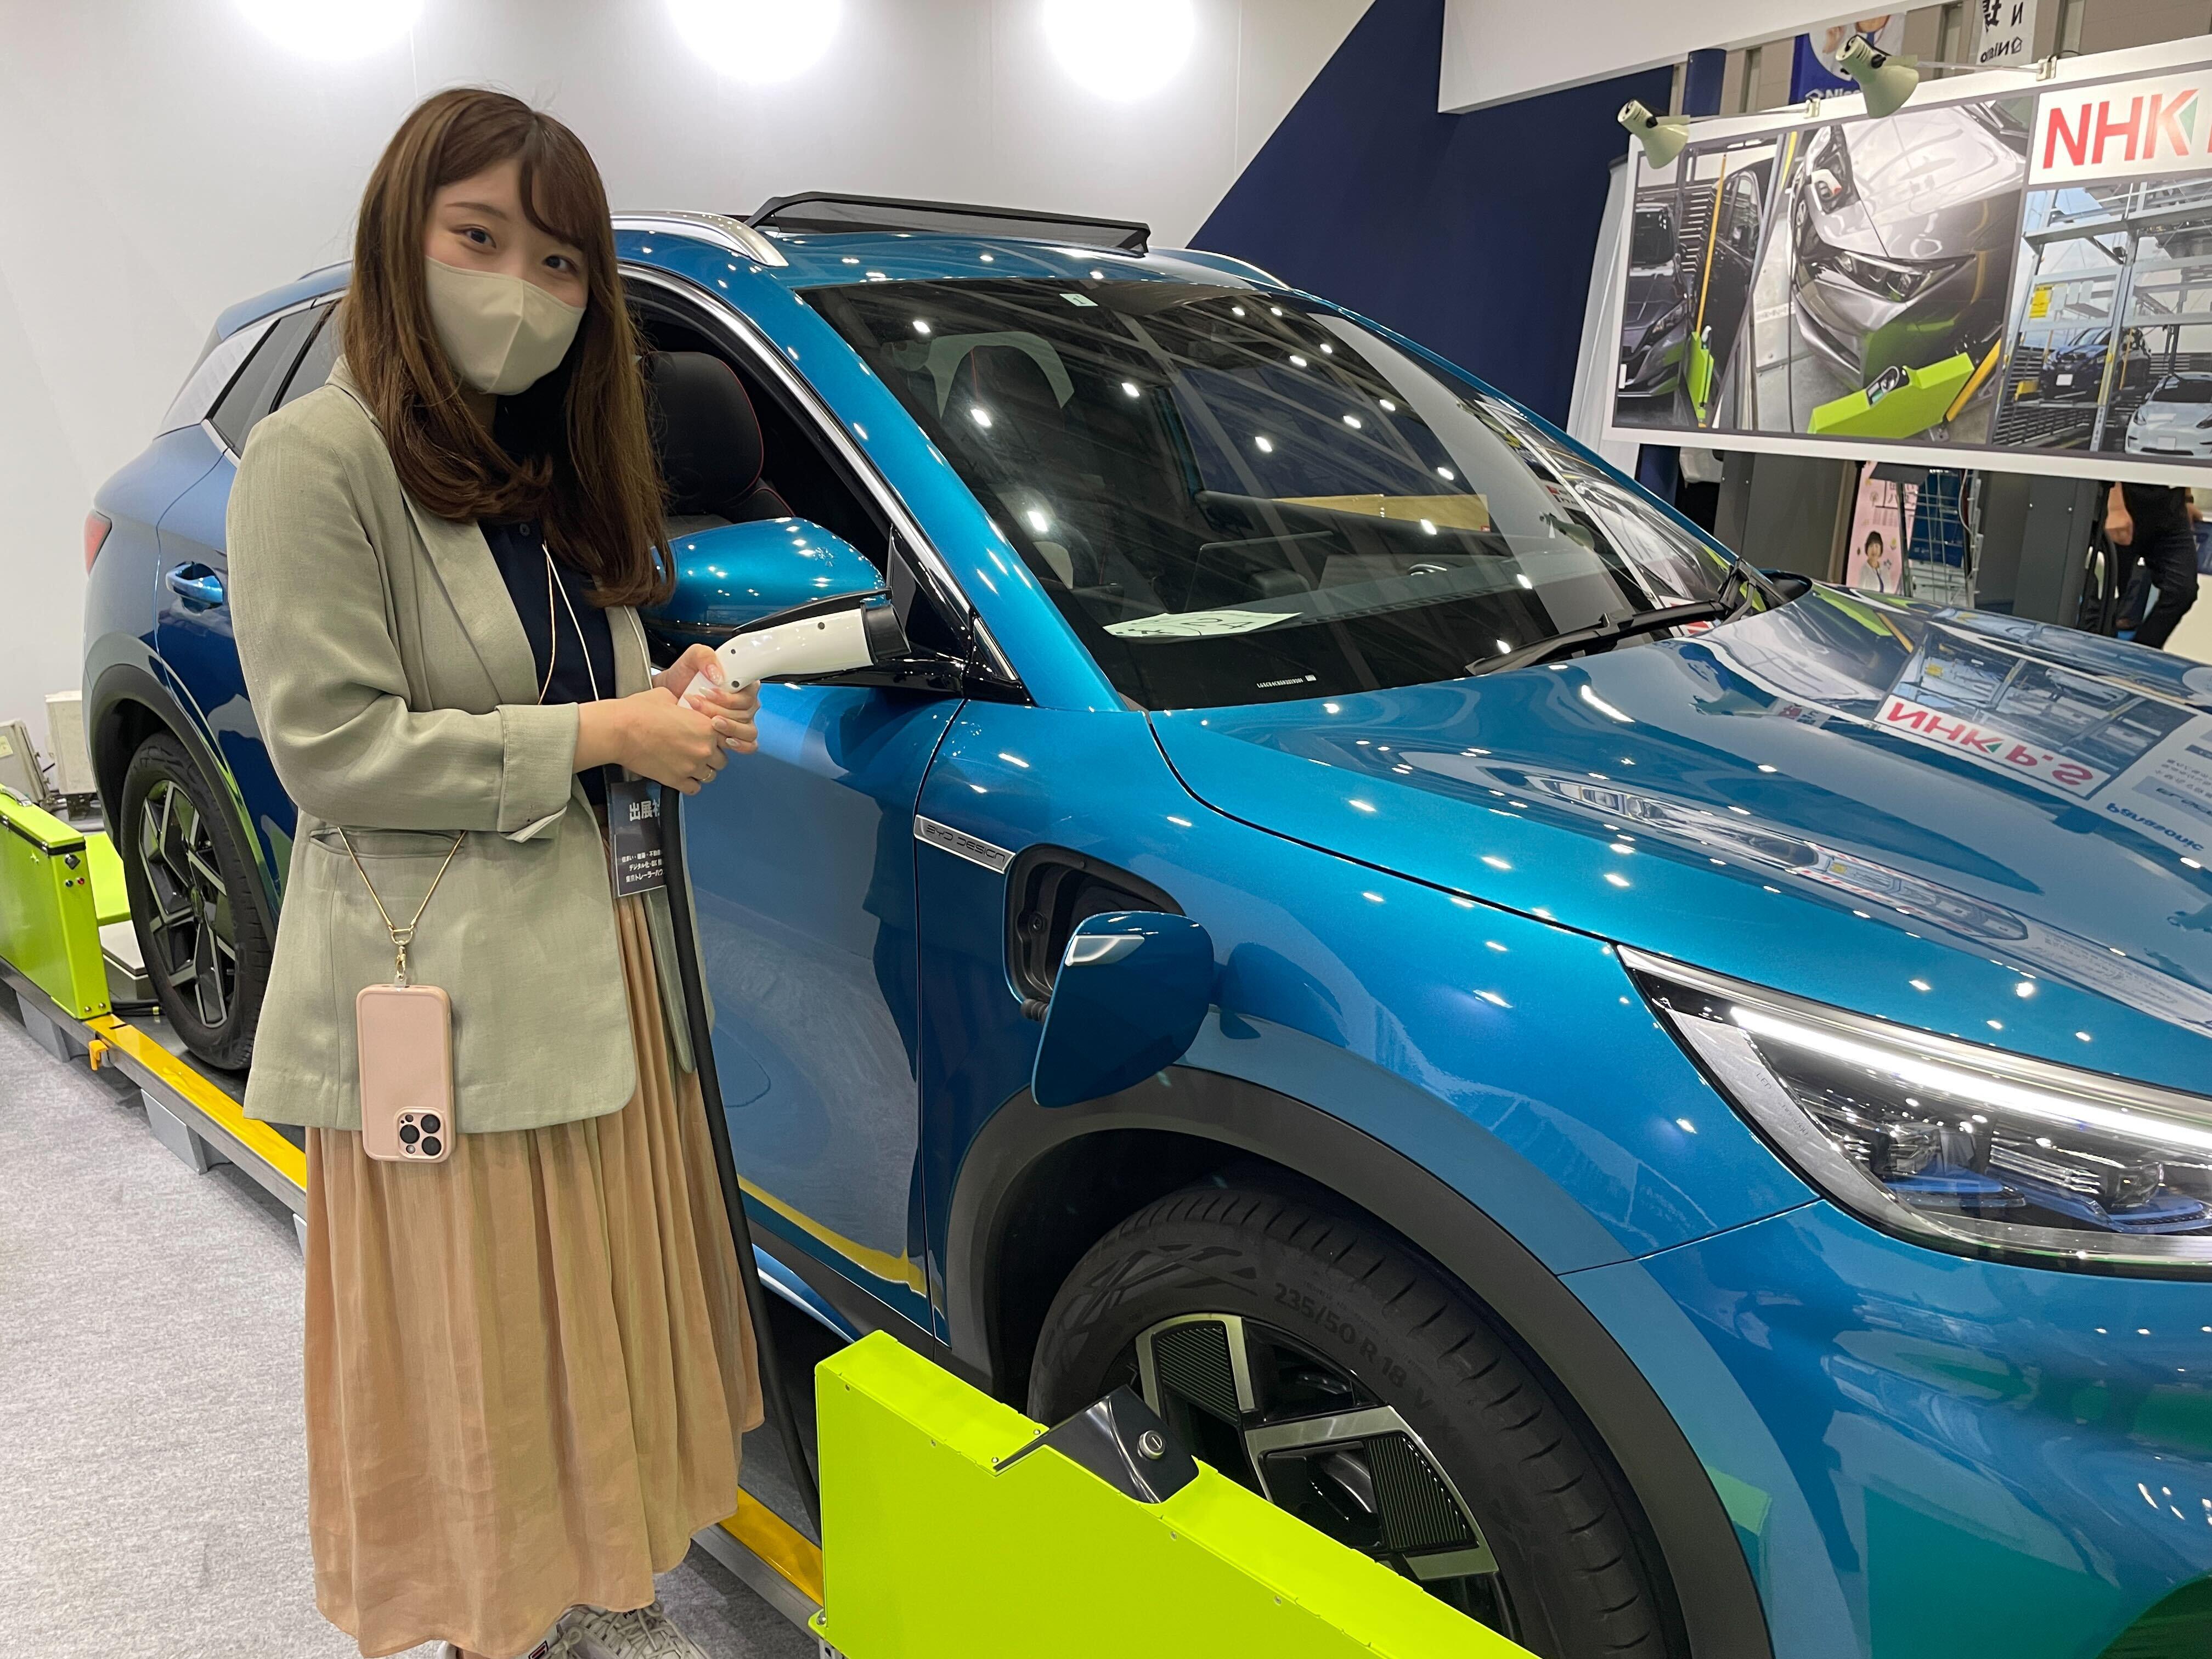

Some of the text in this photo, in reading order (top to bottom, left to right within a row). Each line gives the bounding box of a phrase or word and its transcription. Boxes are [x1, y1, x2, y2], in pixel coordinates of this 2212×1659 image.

[2043, 89, 2198, 169] NHK
[927, 825, 1005, 862] BYD DESIGN
[1274, 1282, 1356, 1344] 235/50
[1359, 1337, 1378, 1364] R
[1382, 1356, 1407, 1388] 18
